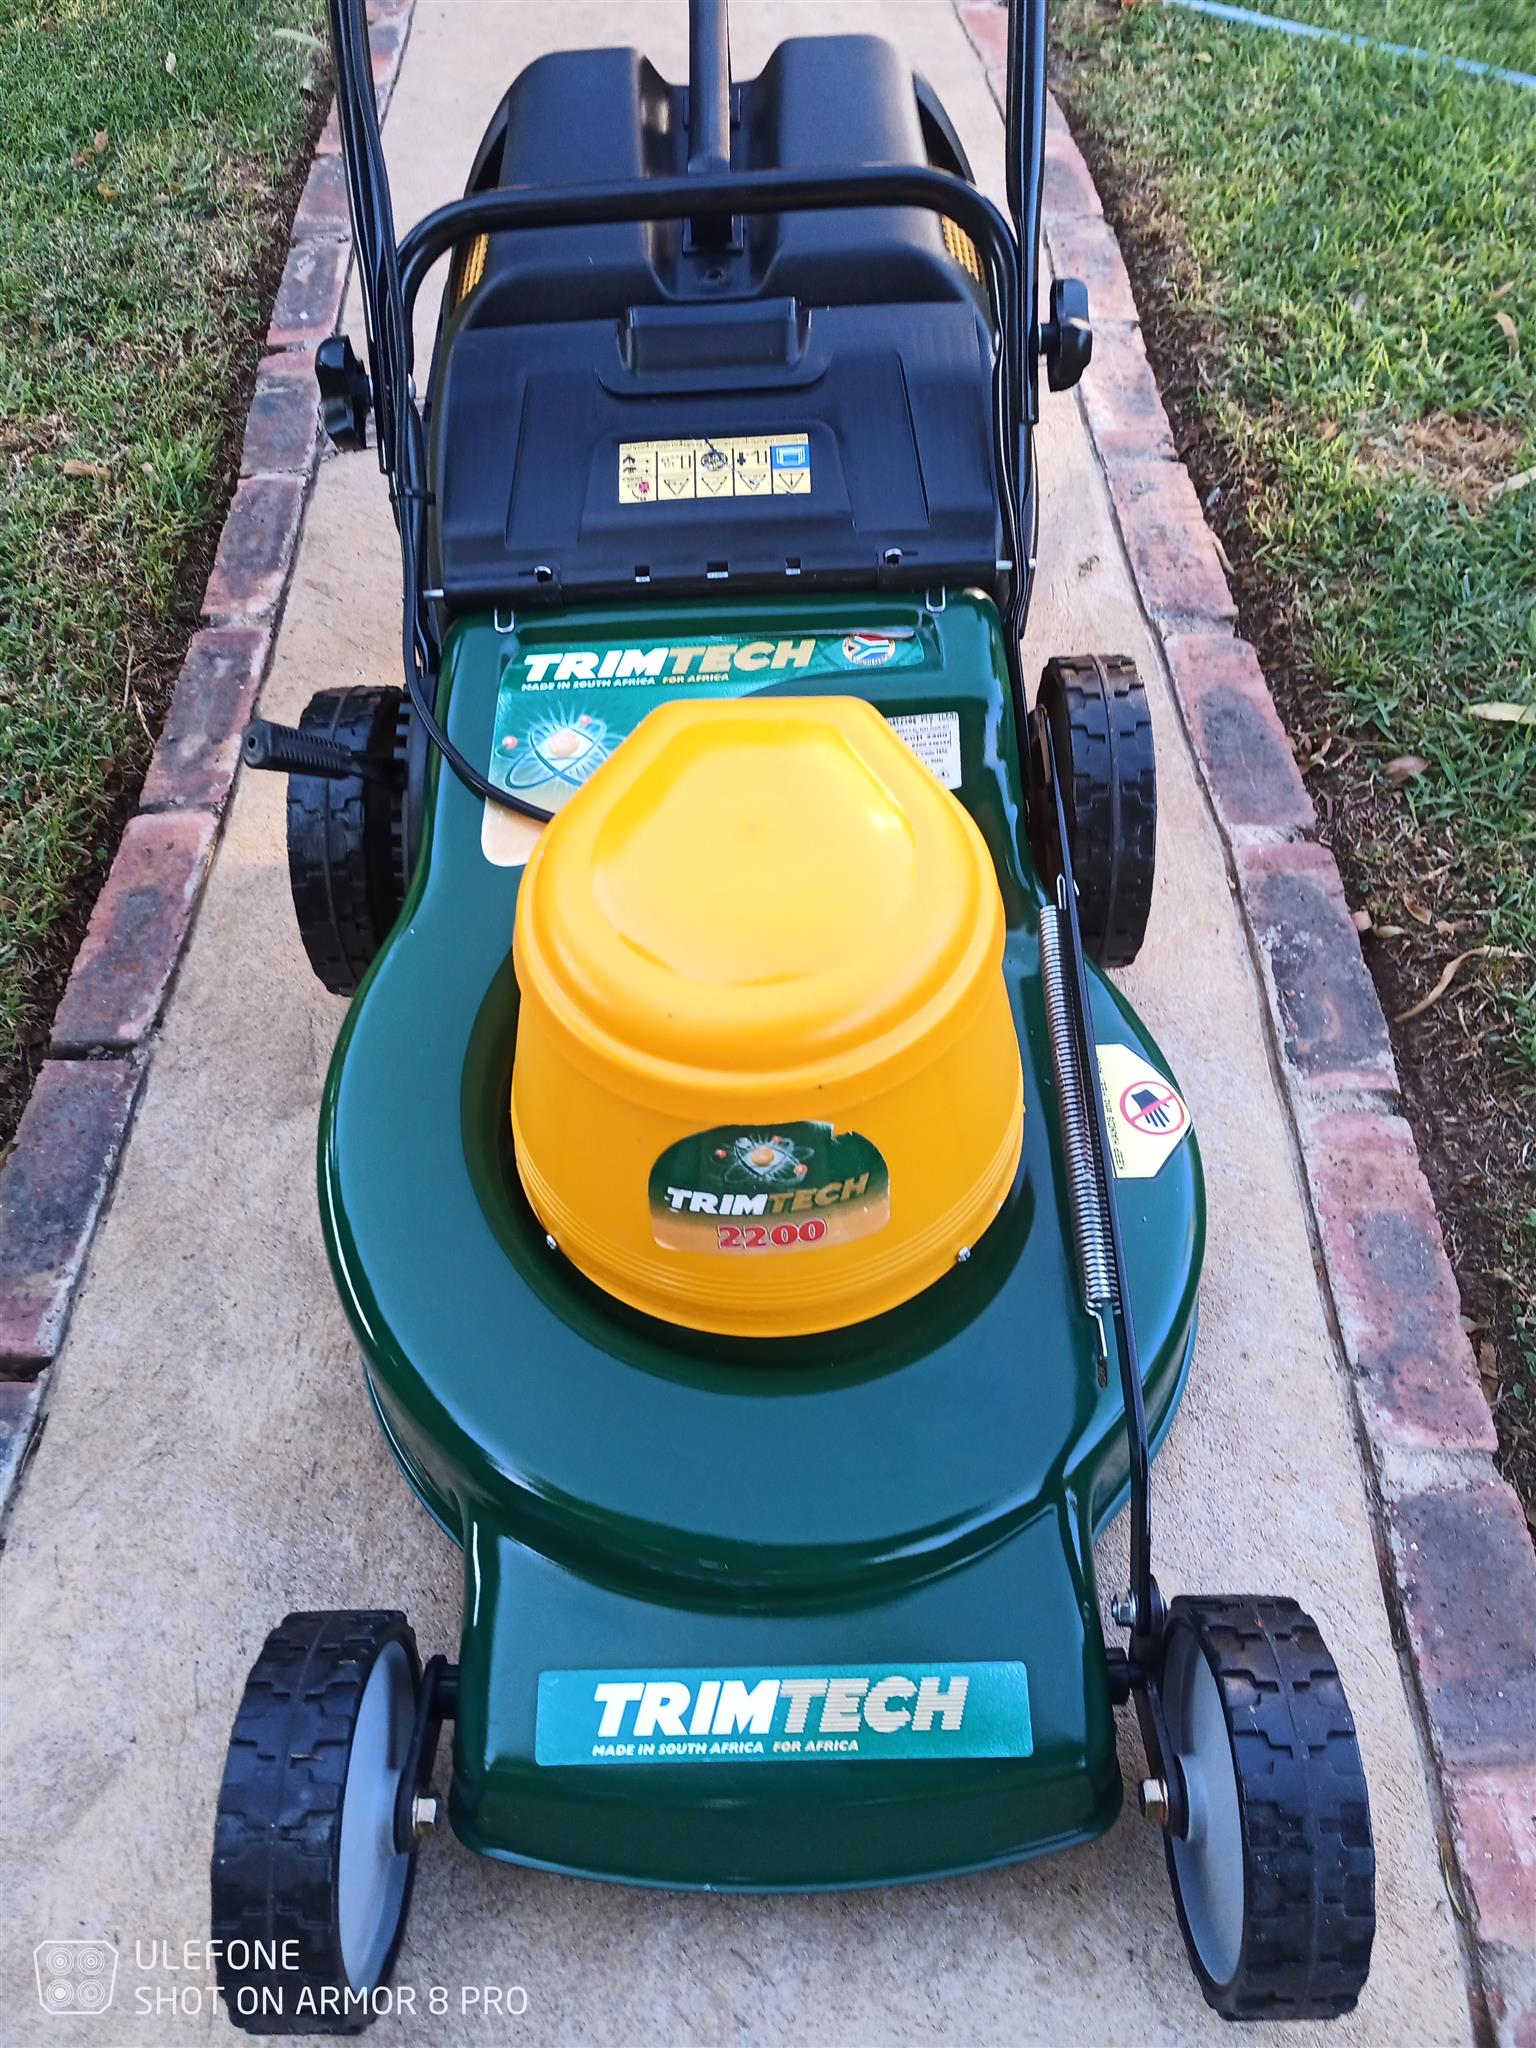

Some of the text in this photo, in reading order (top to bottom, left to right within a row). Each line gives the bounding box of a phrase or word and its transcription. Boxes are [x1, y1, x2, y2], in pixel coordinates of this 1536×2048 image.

[524, 639, 816, 682] TRIMTECH
[521, 673, 729, 692] MADE IN SOUTH AFRICA FOR AFRICA
[667, 1172, 870, 1216] TRIMTECH
[717, 1217, 827, 1250] 2200
[592, 1676, 969, 1737] TRIMTECH
[592, 1739, 859, 1757] MADE IN SOUTH AFRICA FOR AFRICA
